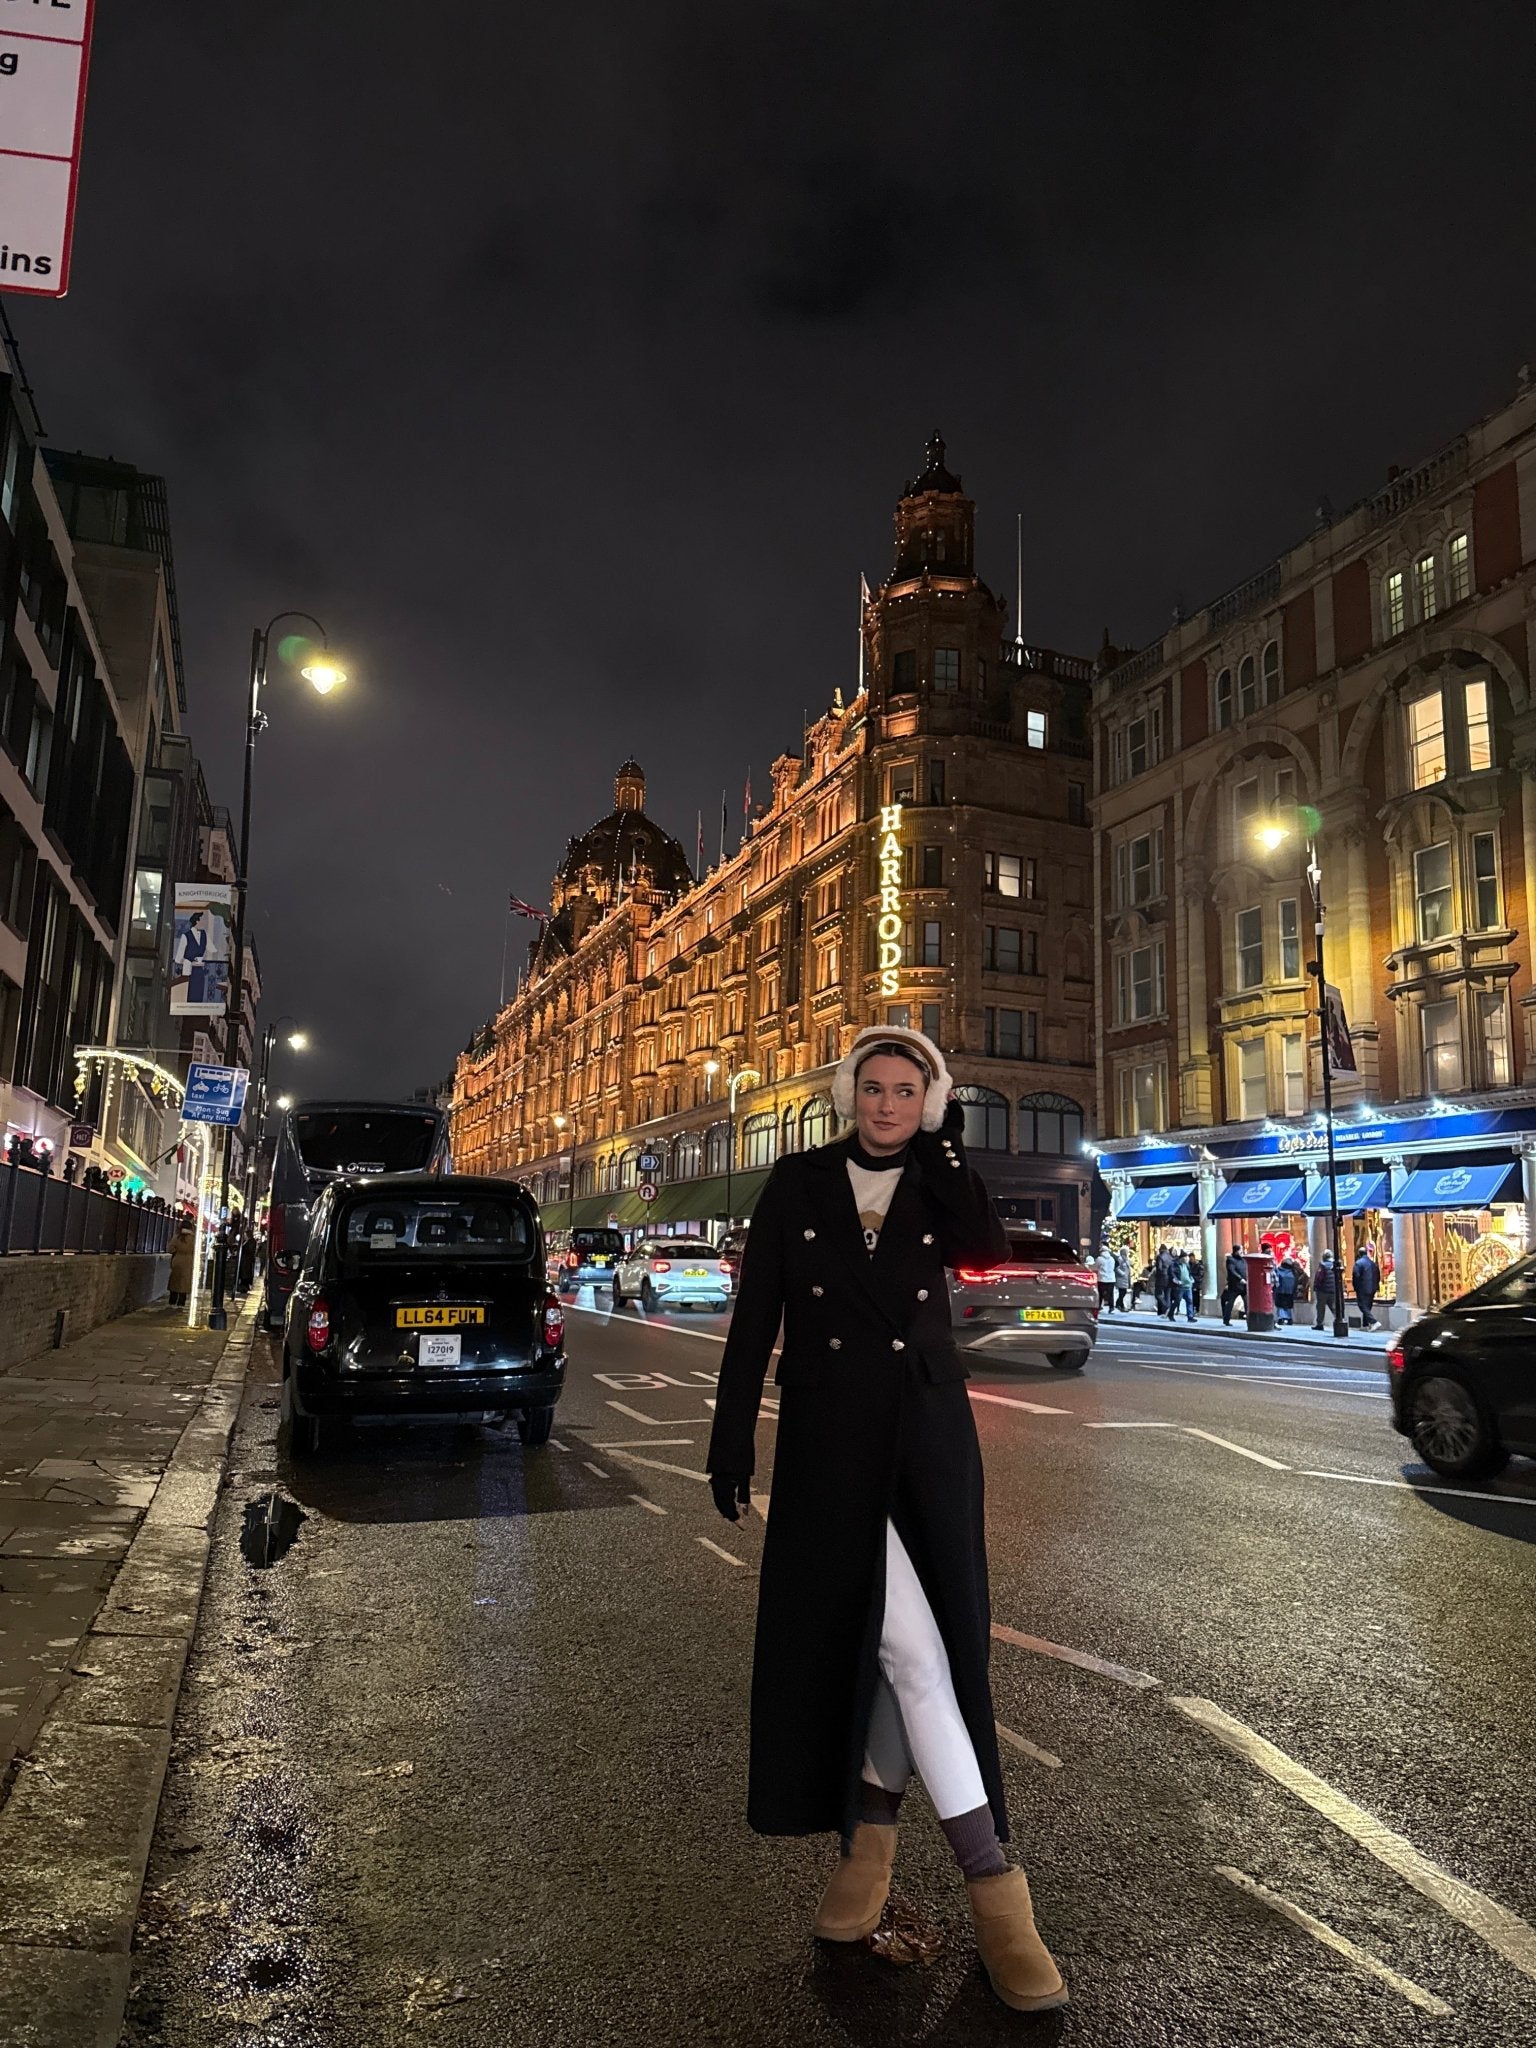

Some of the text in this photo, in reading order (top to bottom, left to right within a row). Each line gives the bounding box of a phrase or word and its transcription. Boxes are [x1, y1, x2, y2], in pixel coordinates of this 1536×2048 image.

[879, 804, 903, 996] HARRODS
[403, 1309, 444, 1324] LL64
[1025, 1311, 1046, 1320] PF74
[428, 1345, 454, 1354] 127019
